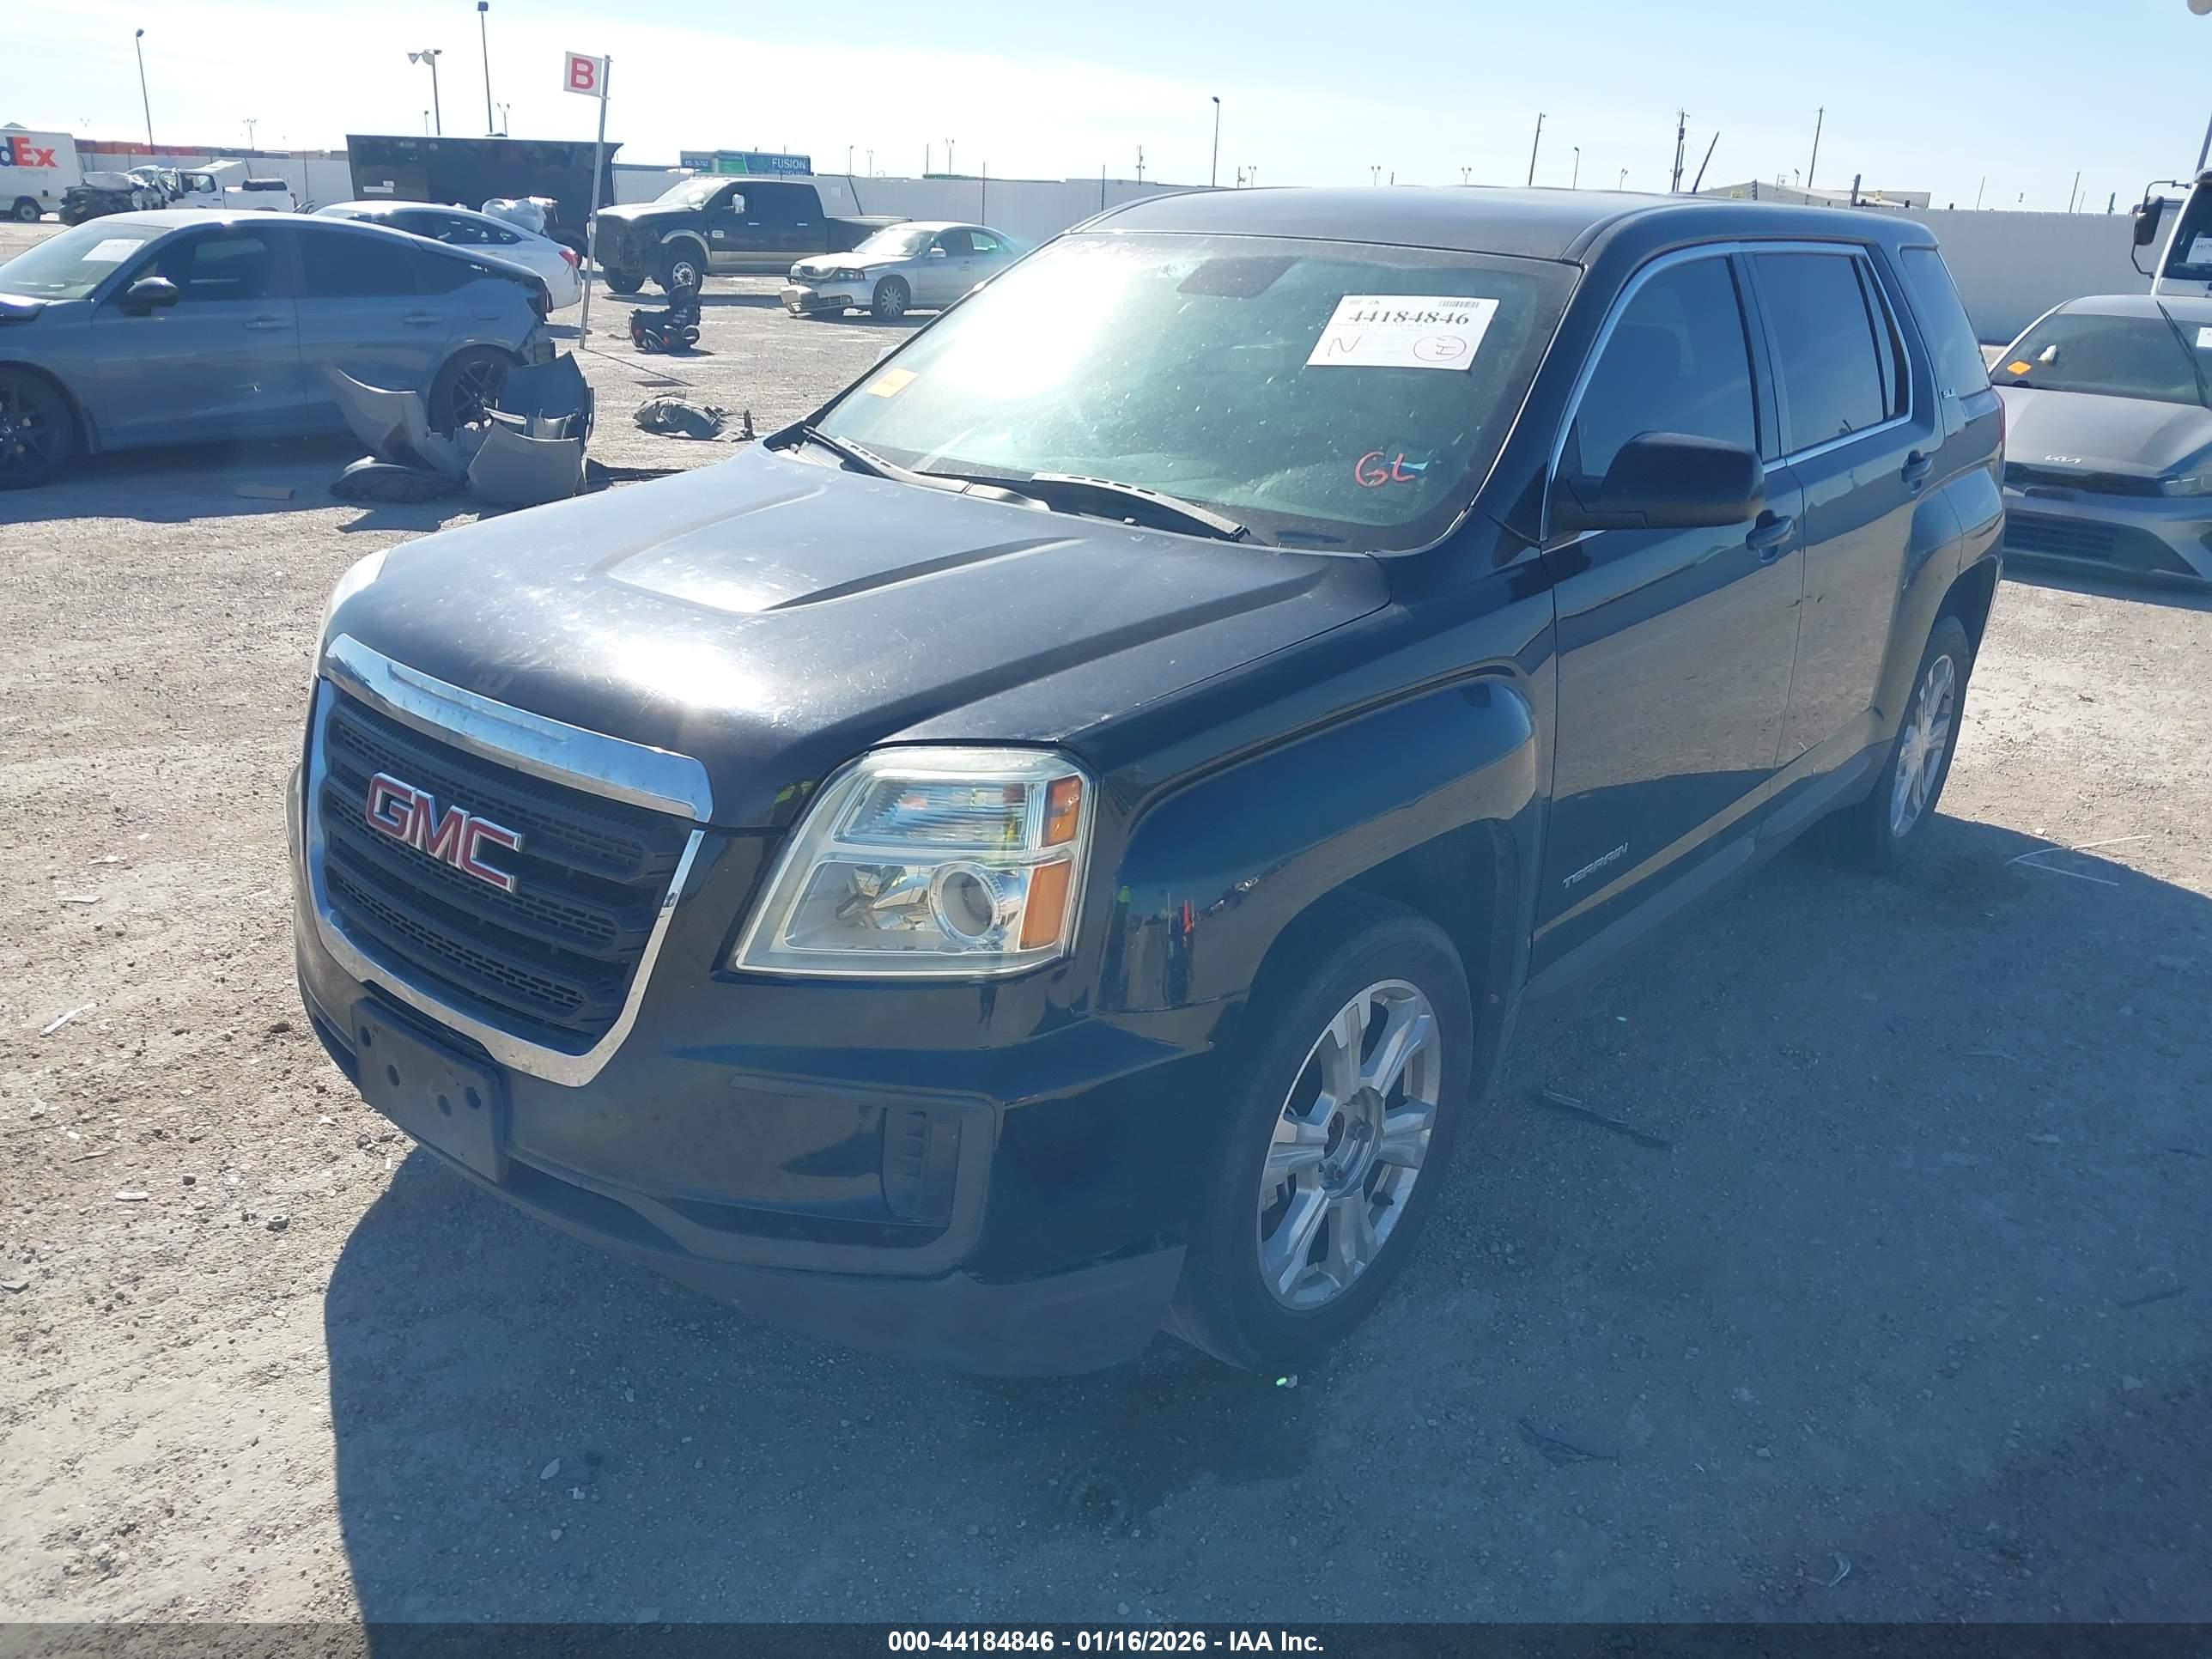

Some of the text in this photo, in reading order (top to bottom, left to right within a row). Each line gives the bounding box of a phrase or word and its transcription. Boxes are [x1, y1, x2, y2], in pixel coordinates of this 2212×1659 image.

[571, 57, 594, 89] B
[772, 158, 806, 169] FUSION
[1348, 310, 1469, 325] 44184846
[366, 772, 522, 893] GMC
[1563, 842, 1629, 889] TERRAIN
